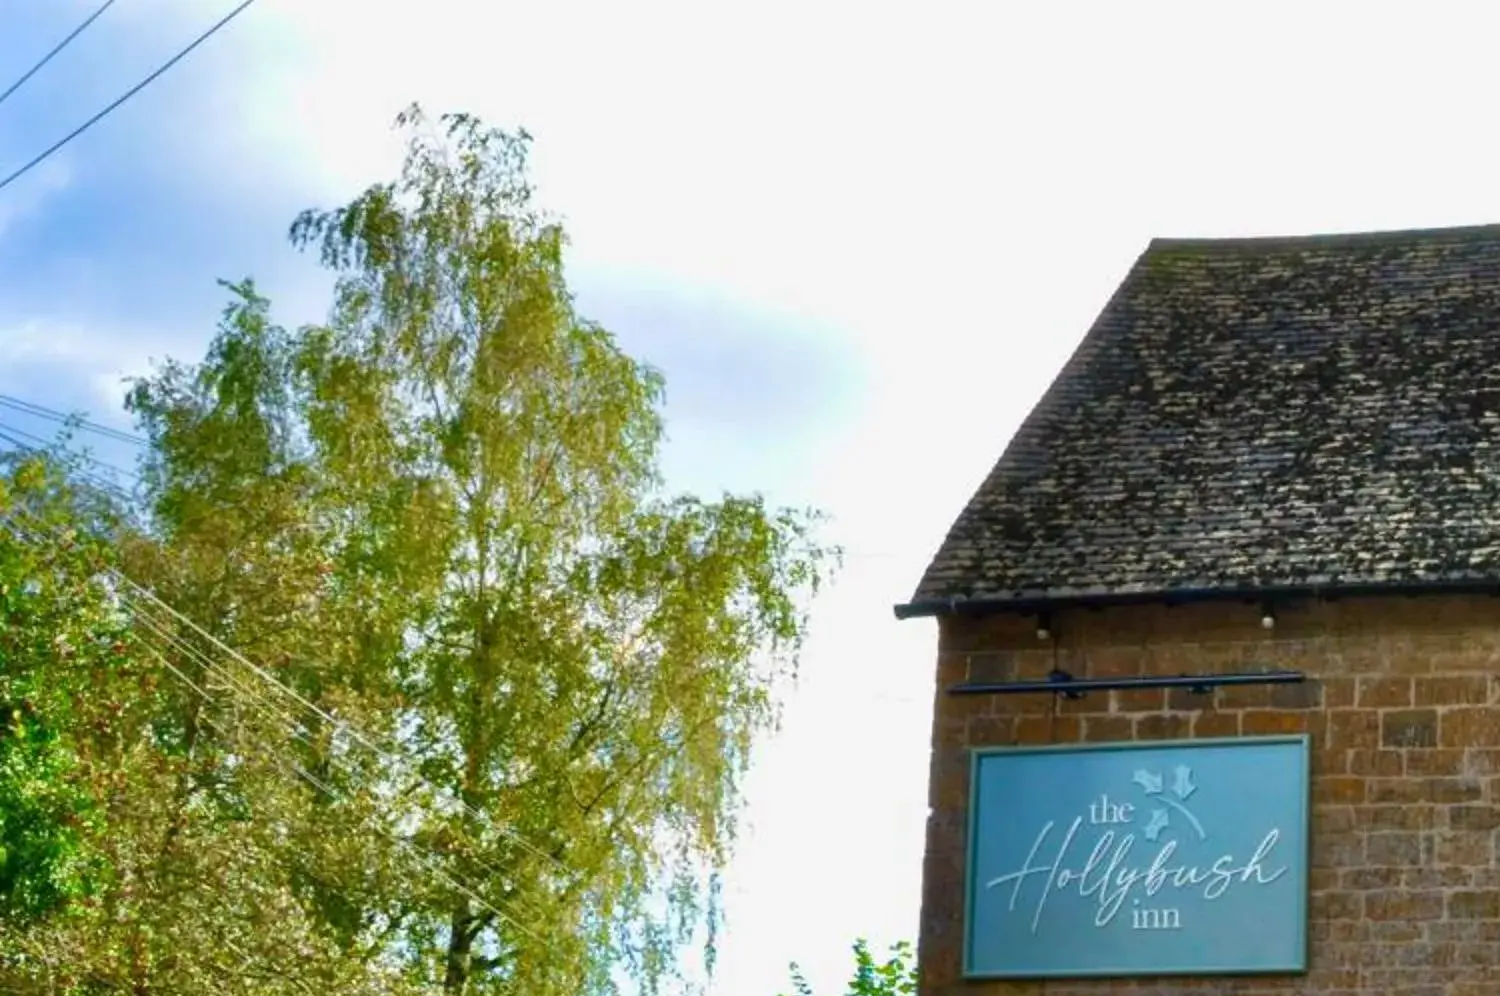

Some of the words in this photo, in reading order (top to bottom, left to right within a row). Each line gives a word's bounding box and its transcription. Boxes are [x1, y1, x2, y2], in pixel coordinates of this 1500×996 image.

[1088, 795, 1136, 825] the
[986, 816, 1288, 934] Hollybush
[1132, 898, 1182, 930] inn
